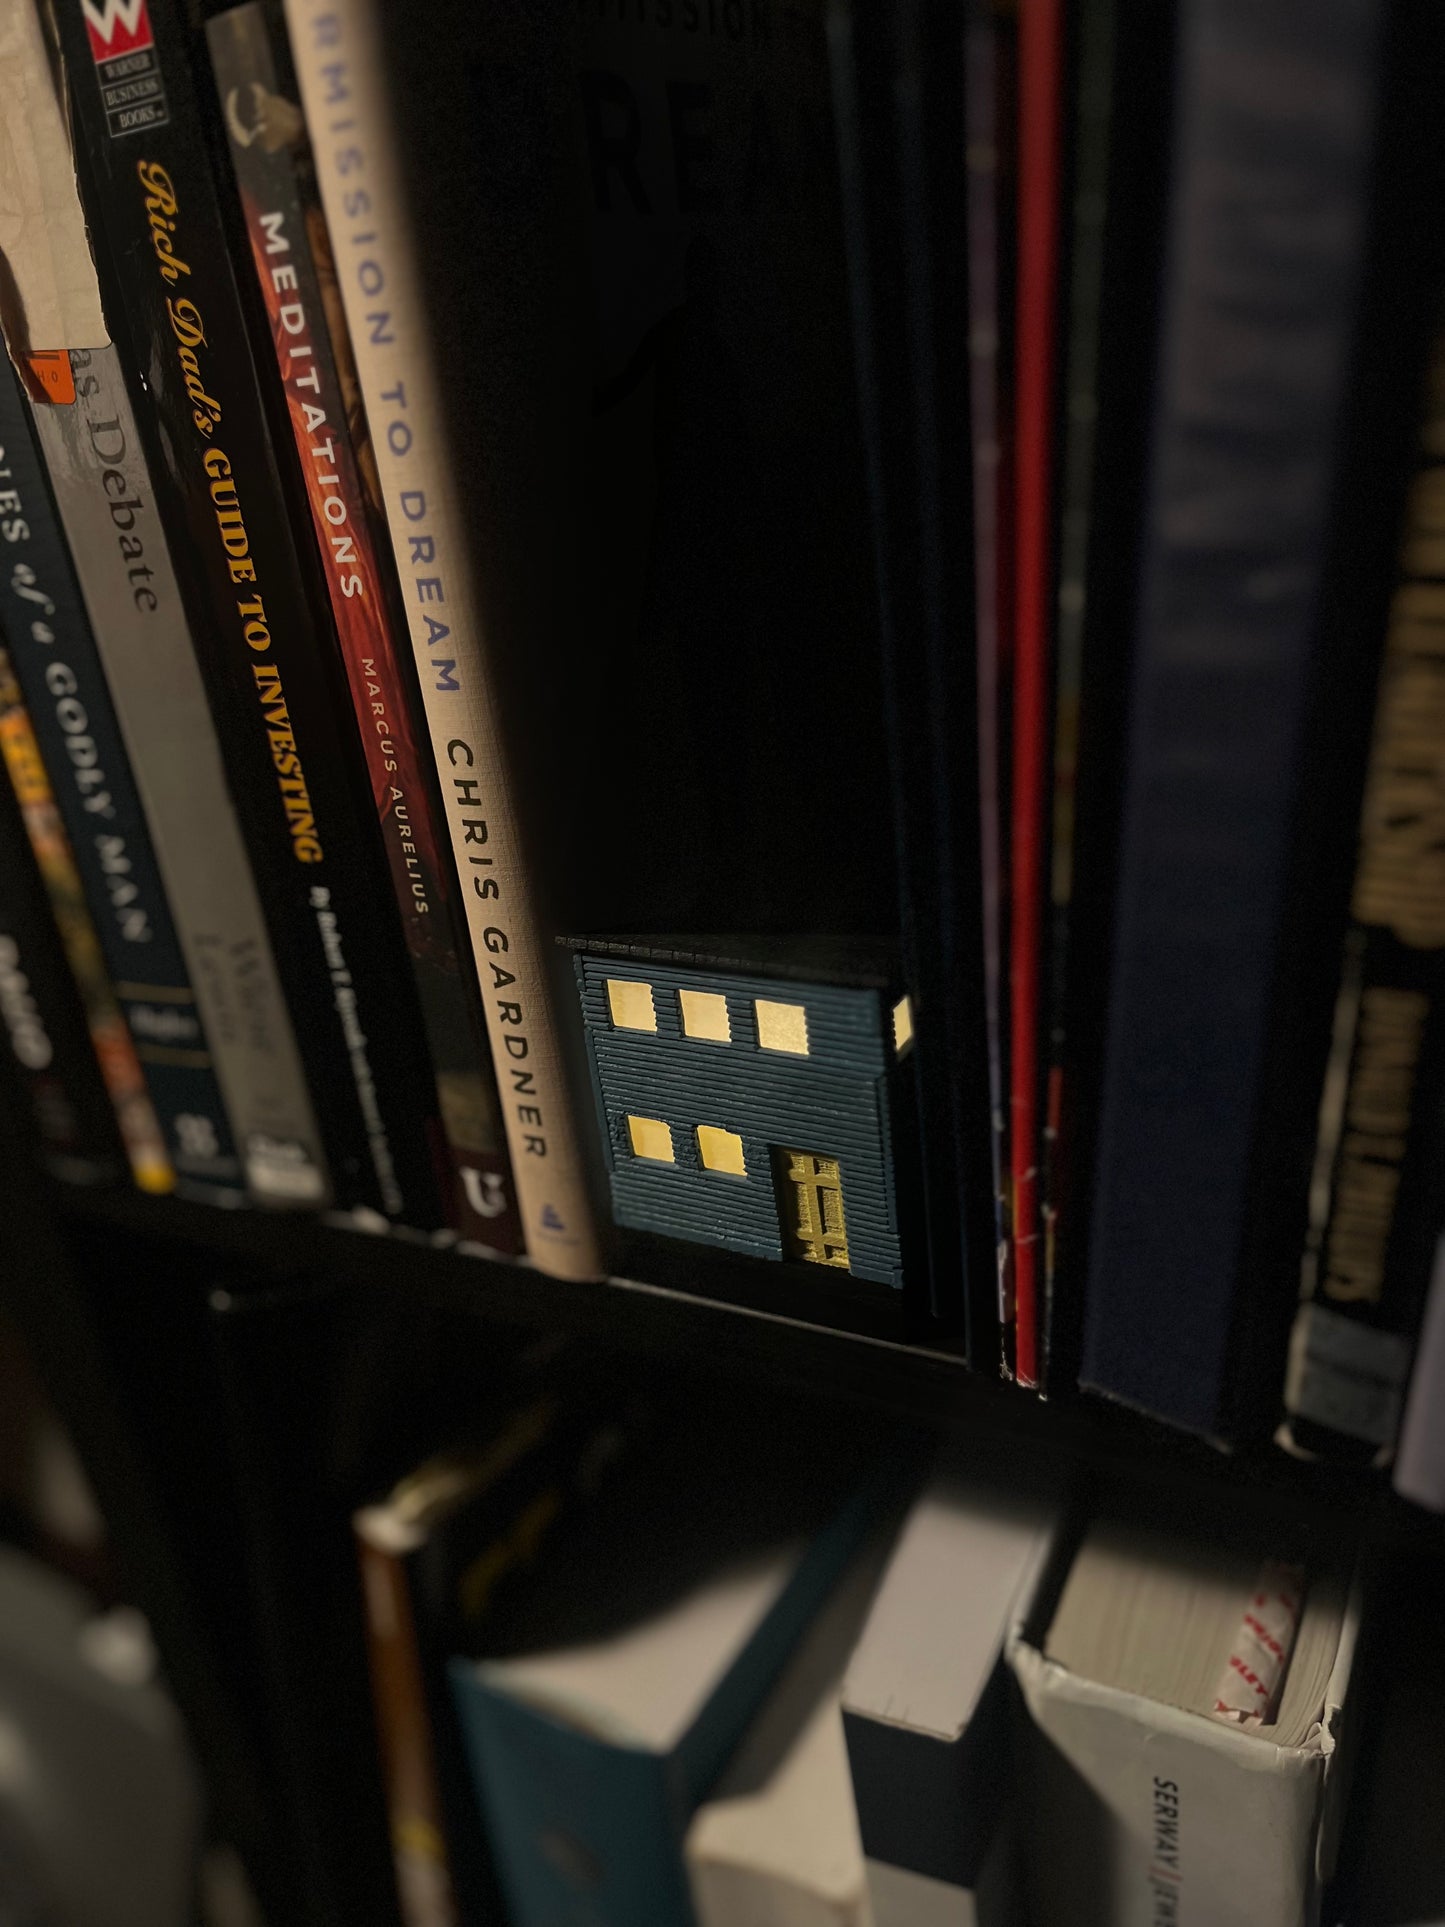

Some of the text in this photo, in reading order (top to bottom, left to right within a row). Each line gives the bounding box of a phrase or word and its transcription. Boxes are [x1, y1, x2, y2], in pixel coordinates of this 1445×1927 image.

[105, 77, 159, 106] BUSINESS
[119, 105, 156, 128] BOOKS
[87, 413, 158, 614] Debate
[136, 158, 324, 865] Rich Dad's GUIDE TO INVESTING
[259, 211, 363, 600] MEDITATIONS
[381, 380, 413, 457] TO
[400, 490, 461, 691] DREAM
[361, 658, 429, 915] MARCUS AURELIUS
[446, 738, 548, 1160] CHRIS GARDNER
[1152, 1775, 1179, 1870] SERWAY
